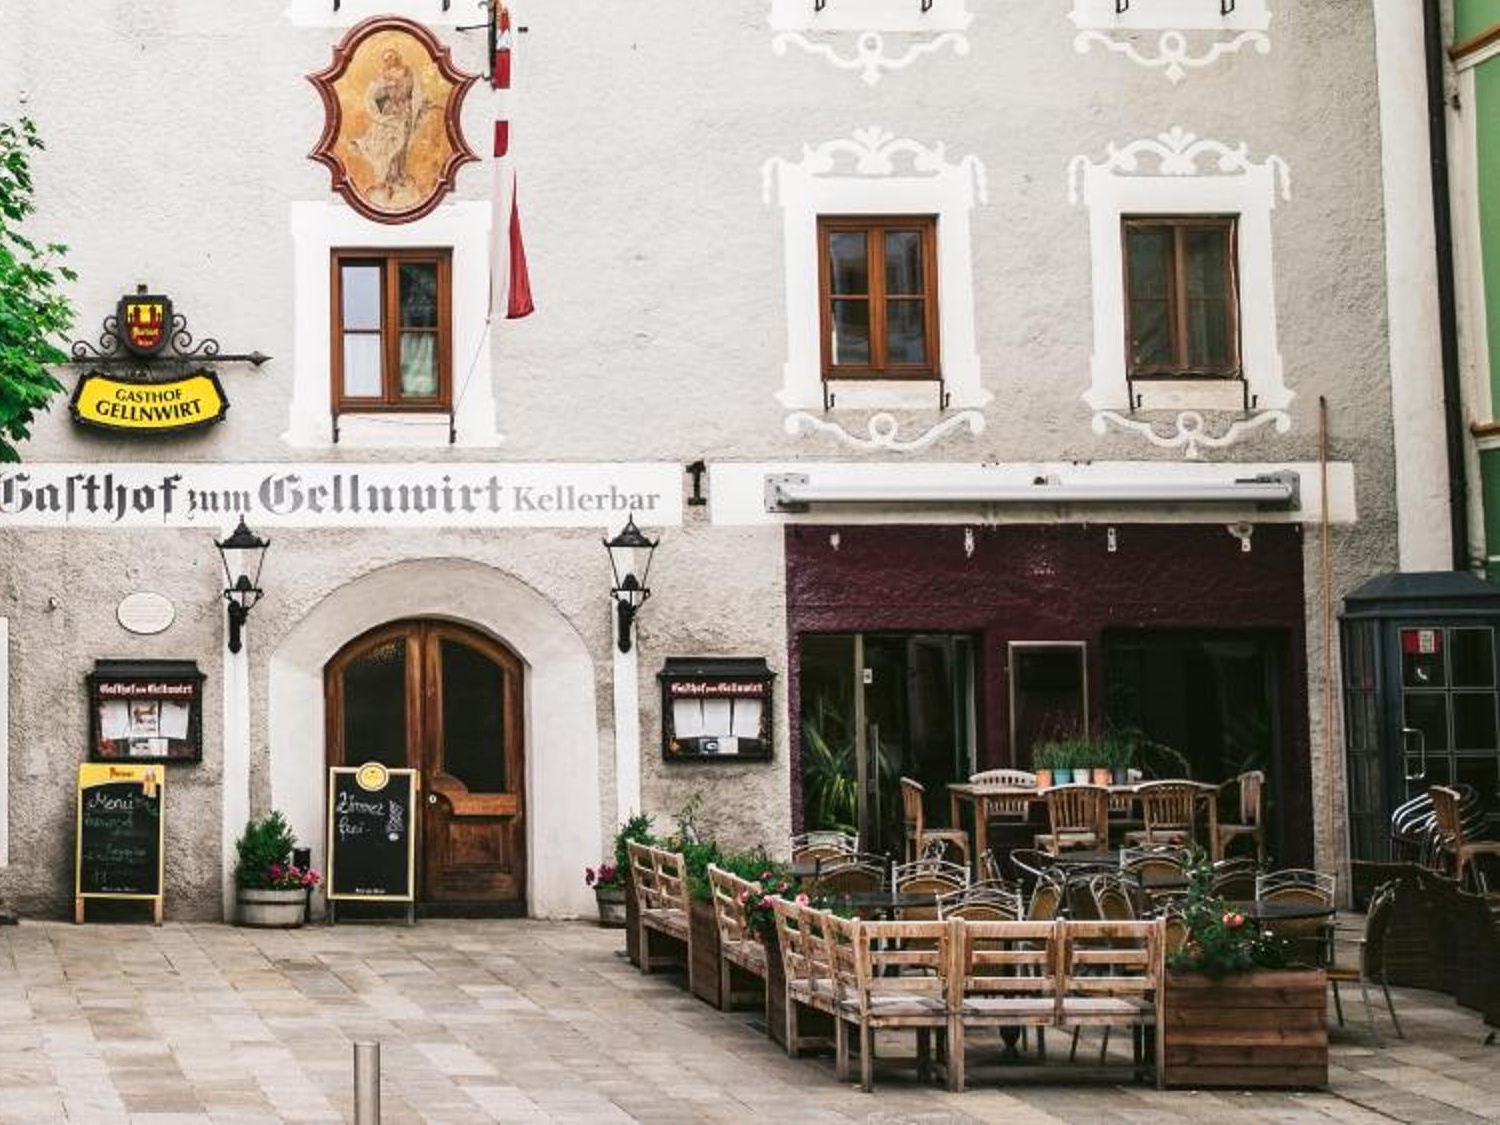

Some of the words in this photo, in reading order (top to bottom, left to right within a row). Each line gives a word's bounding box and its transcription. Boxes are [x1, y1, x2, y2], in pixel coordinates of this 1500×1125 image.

[115, 388, 183, 402] GASTHOF
[95, 399, 202, 421] GELLNWIRT
[188, 488, 251, 520] zum
[258, 473, 504, 515] Gellnwirt
[512, 485, 661, 512] Kellerbar
[89, 792, 134, 811] Menü
